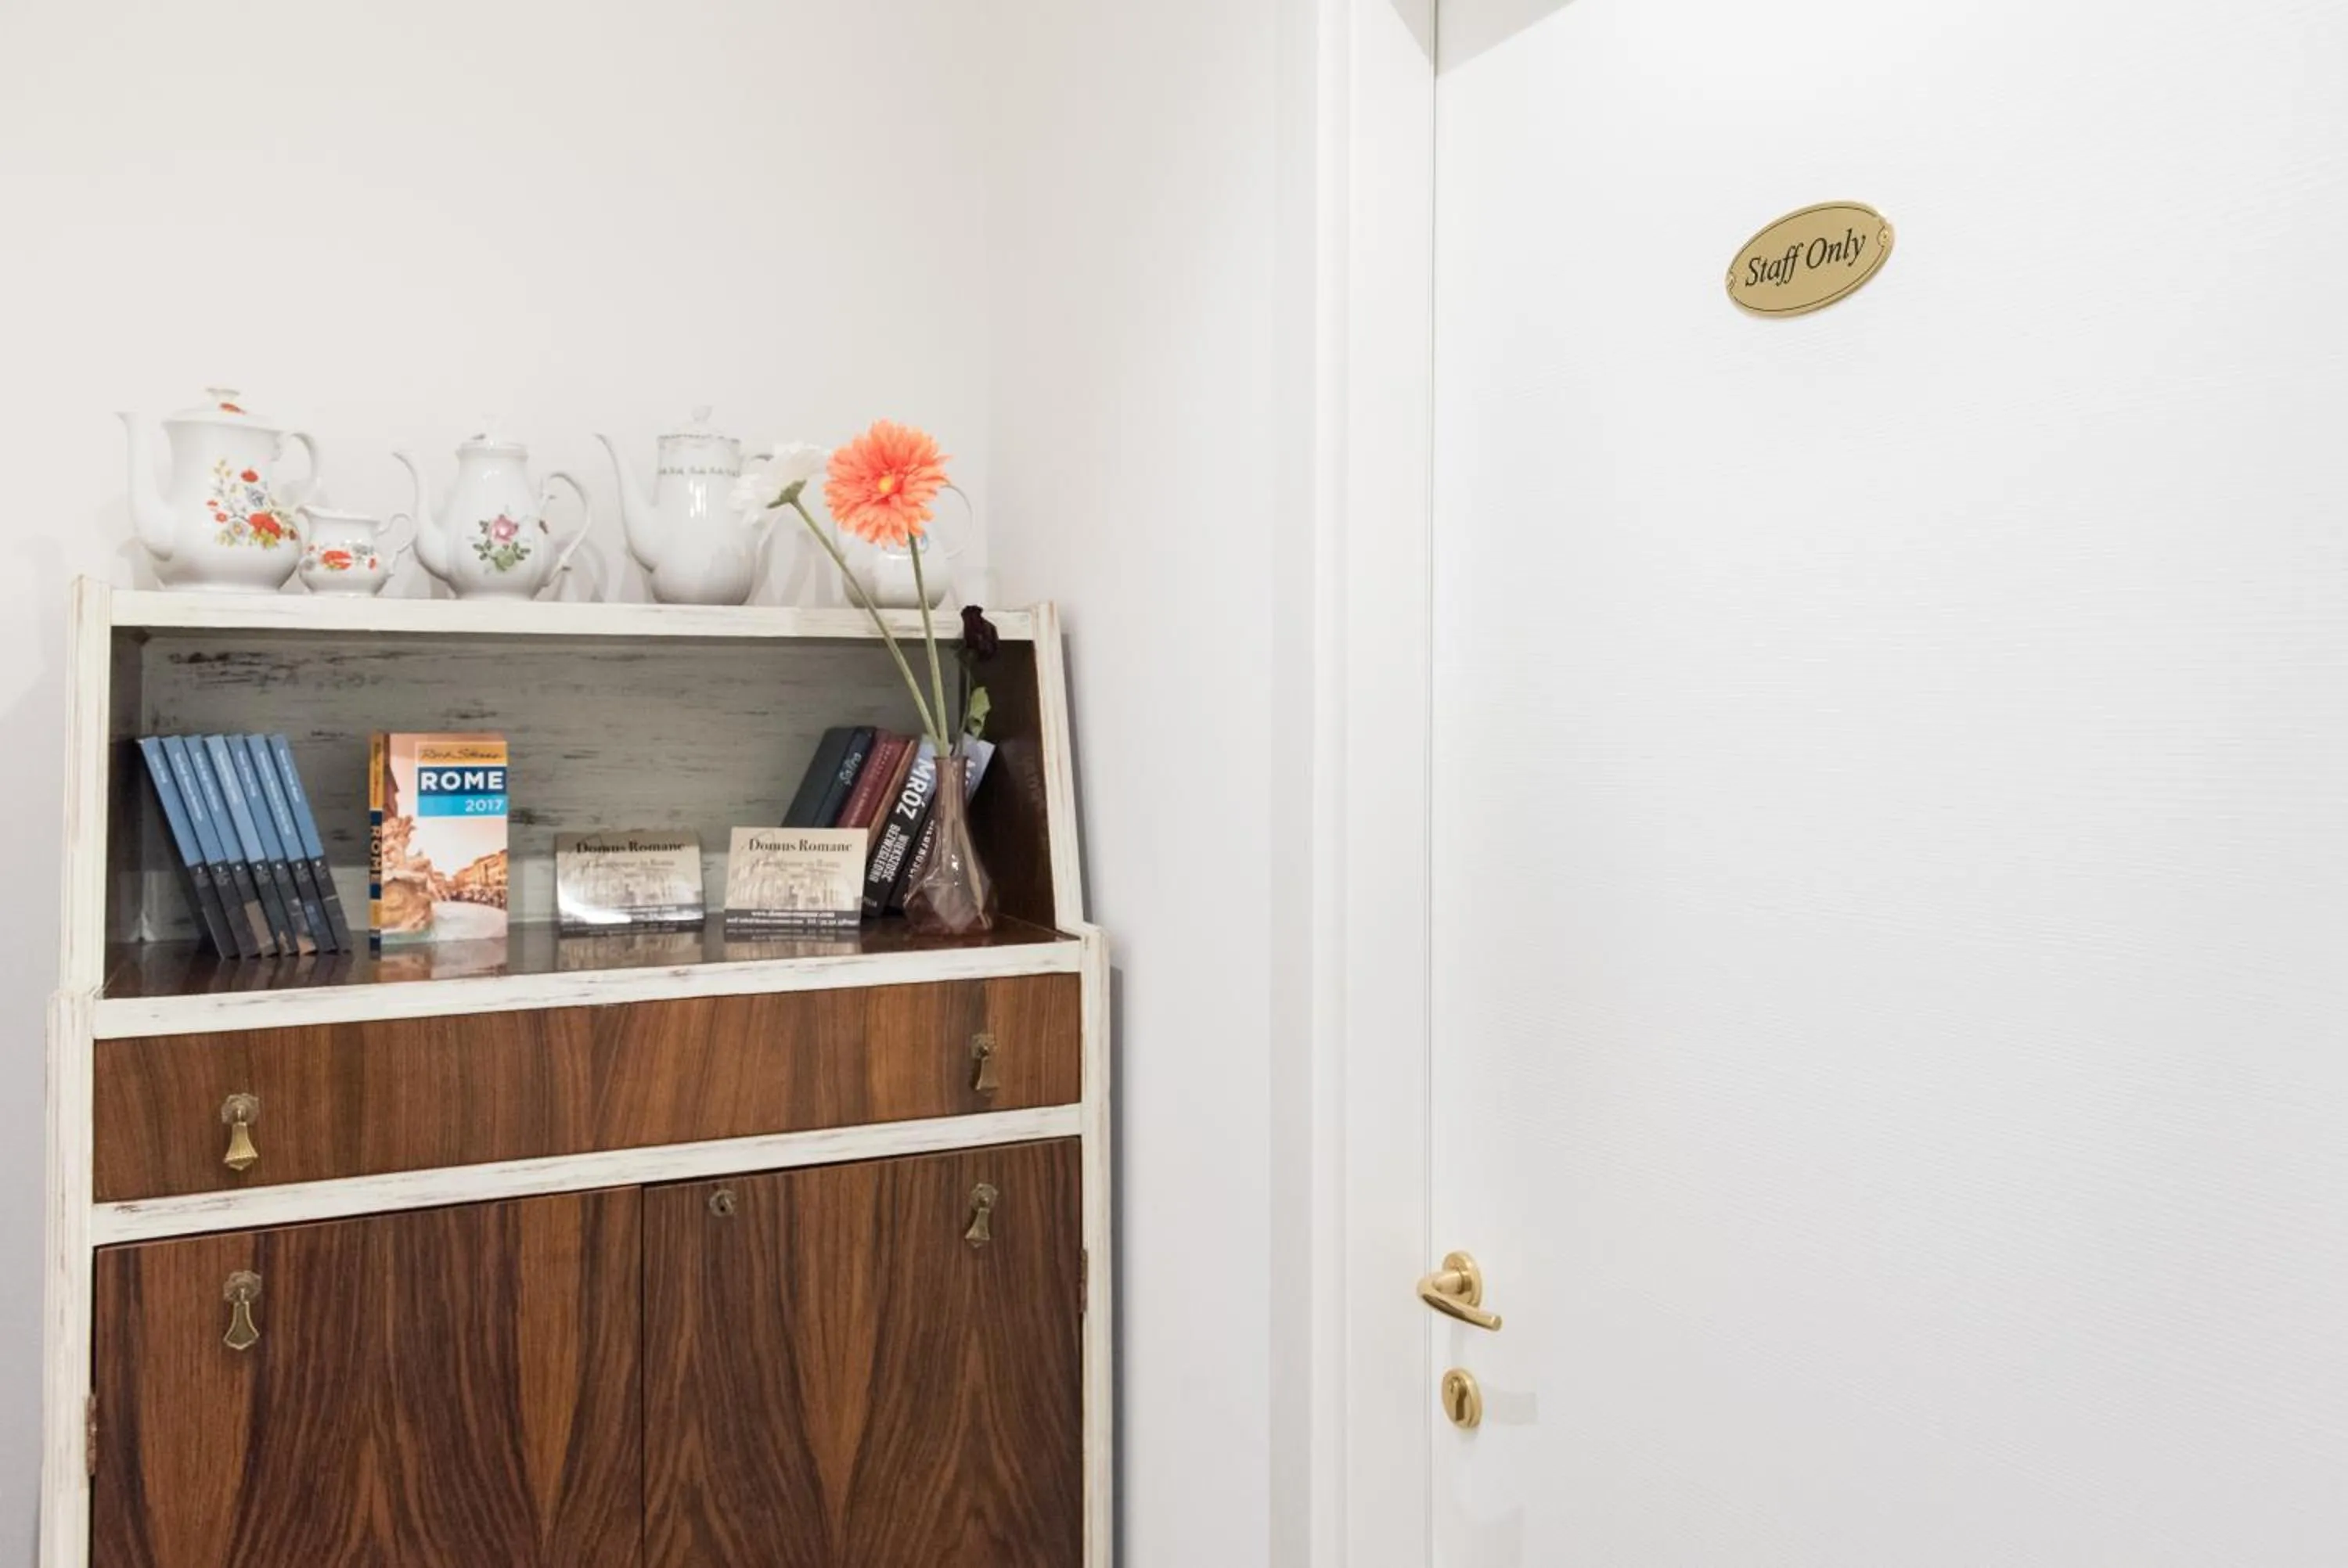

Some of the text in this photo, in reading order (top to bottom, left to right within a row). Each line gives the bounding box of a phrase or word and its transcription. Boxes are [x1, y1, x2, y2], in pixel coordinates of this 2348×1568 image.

[1745, 228, 1867, 286] Staff Only
[420, 771, 504, 790] ROME
[895, 758, 936, 819] MRÓZ
[465, 799, 504, 812] 2017
[748, 838, 796, 851] Domus
